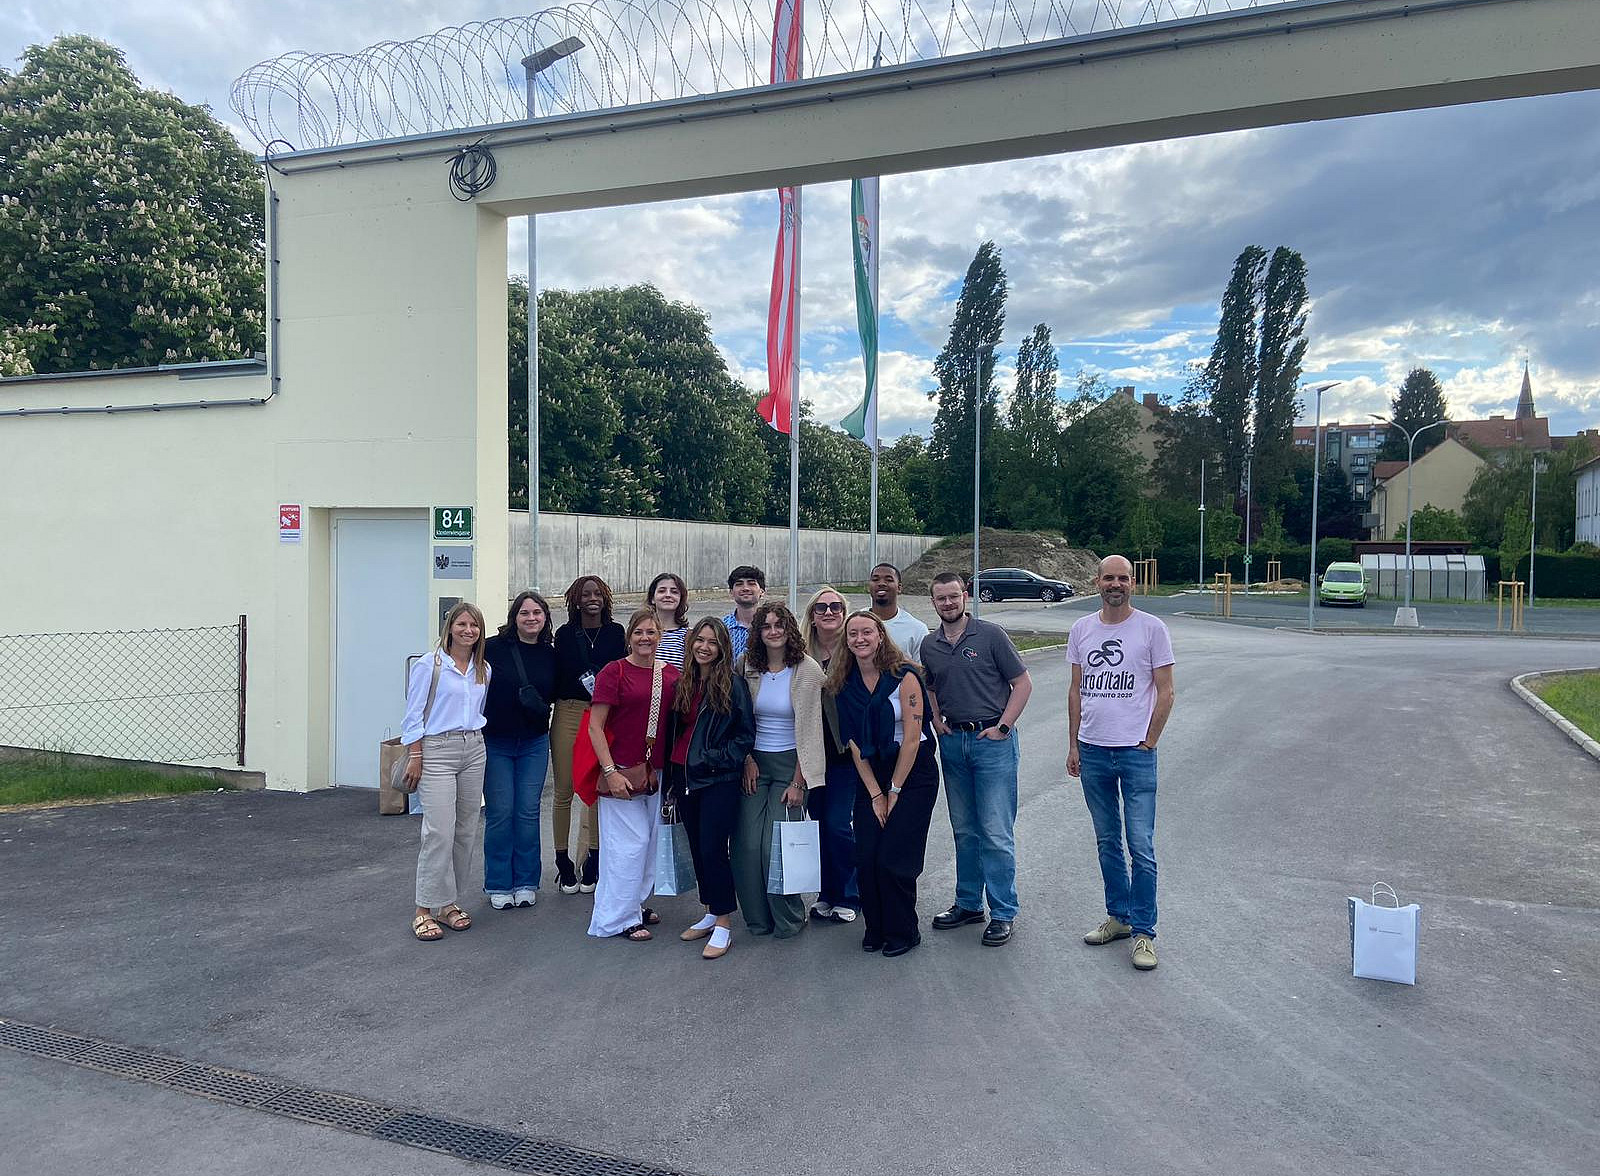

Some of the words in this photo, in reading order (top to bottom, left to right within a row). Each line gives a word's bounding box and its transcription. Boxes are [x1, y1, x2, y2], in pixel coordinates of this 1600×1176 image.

[442, 509, 464, 528] 84
[1080, 674, 1096, 690] iro
[1096, 671, 1135, 690] d'Italia
